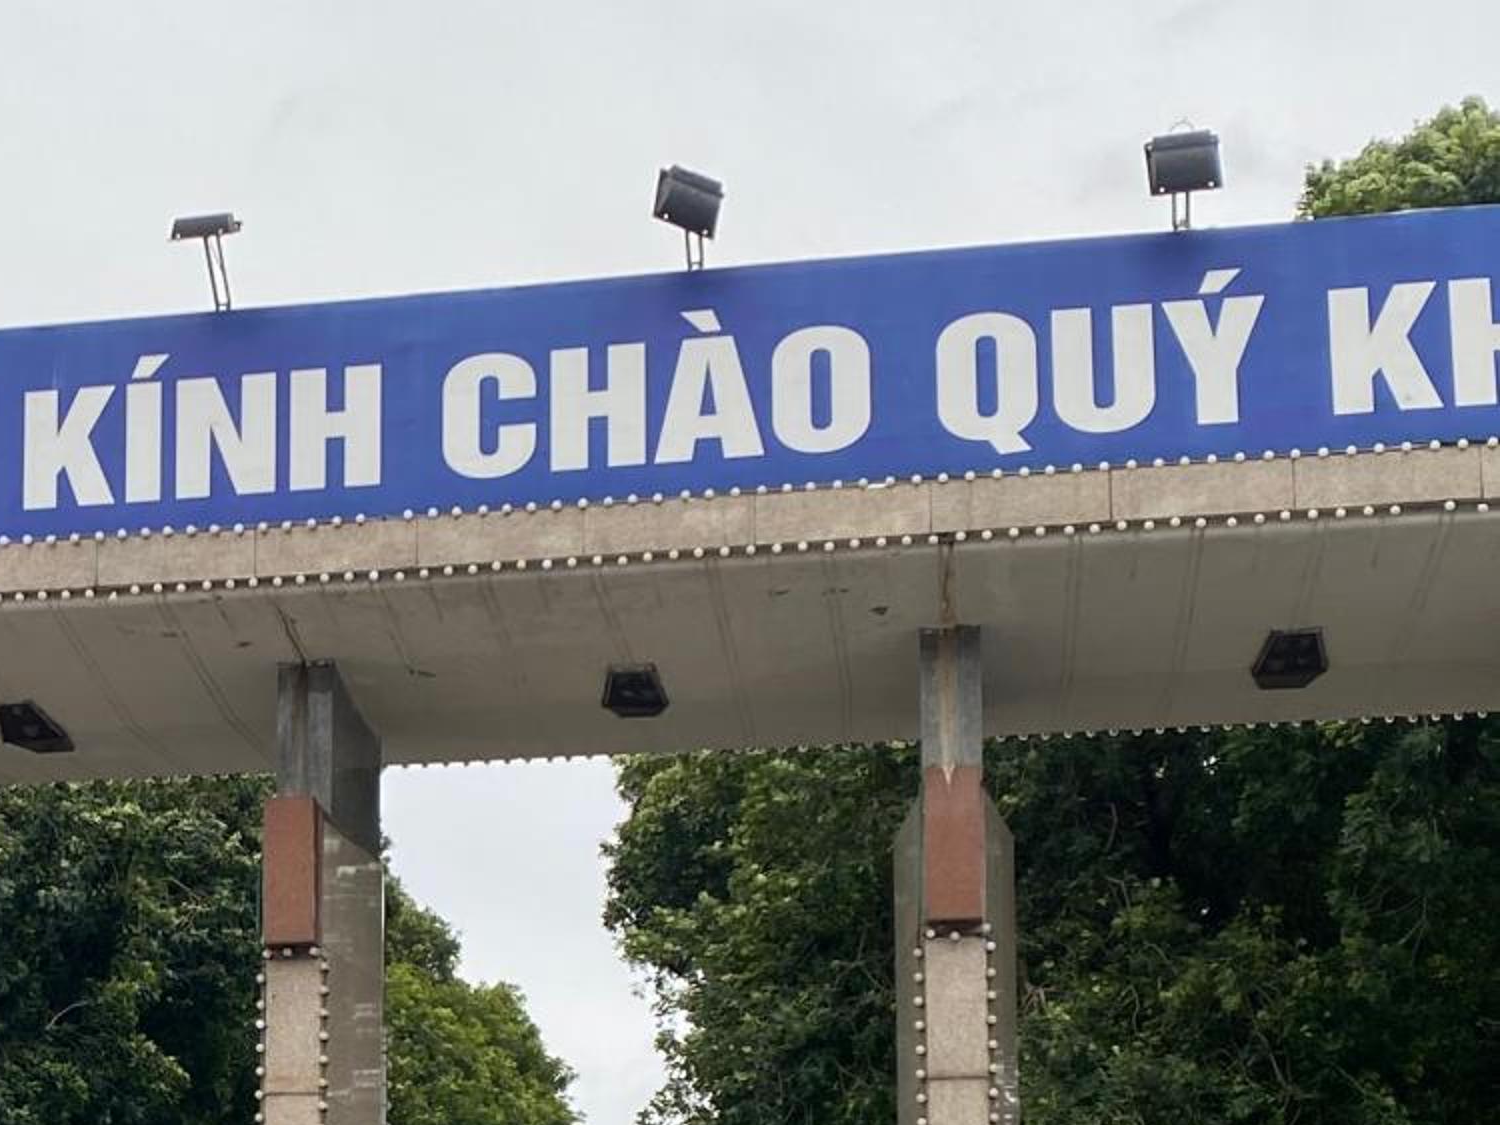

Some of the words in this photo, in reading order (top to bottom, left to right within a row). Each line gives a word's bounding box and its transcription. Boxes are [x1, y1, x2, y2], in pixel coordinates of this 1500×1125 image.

[22, 353, 382, 511] KÍNH
[442, 309, 872, 479] CHÀO
[935, 268, 1265, 455] QUÝ
